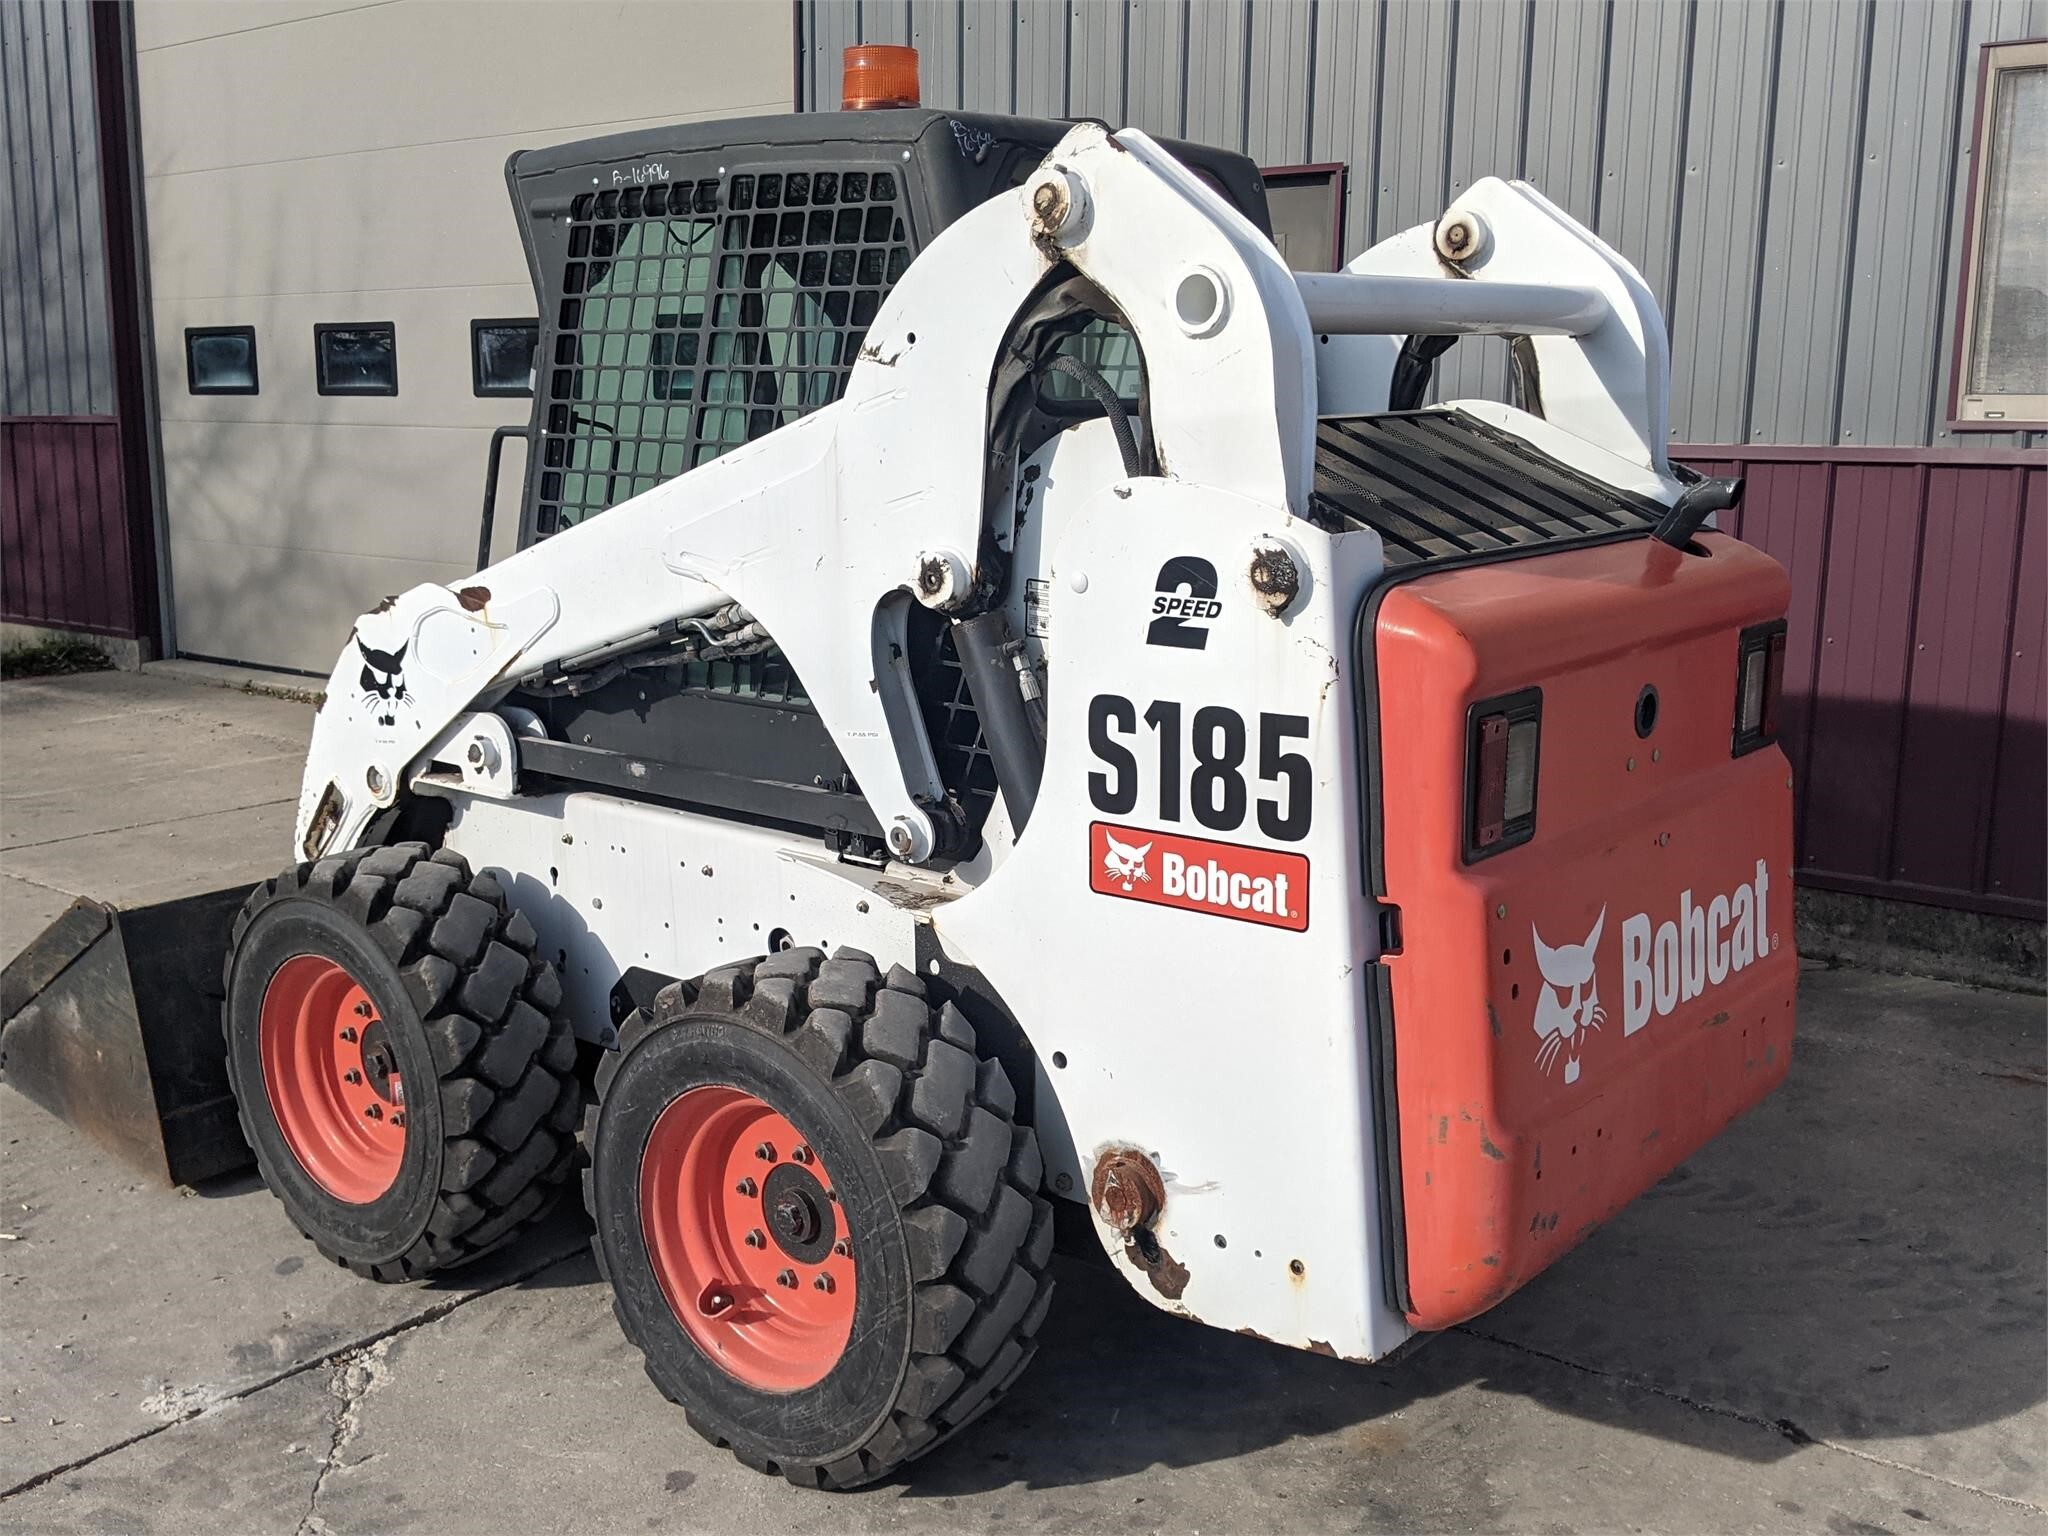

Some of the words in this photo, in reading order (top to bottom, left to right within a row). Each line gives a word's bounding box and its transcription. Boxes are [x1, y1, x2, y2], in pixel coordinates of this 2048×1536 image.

[1146, 555, 1219, 650] 2
[1152, 596, 1223, 619] SPEED
[1088, 693, 1313, 842] S185
[1162, 851, 1289, 918] Bobcat
[1622, 858, 1769, 1038] Bobcat
